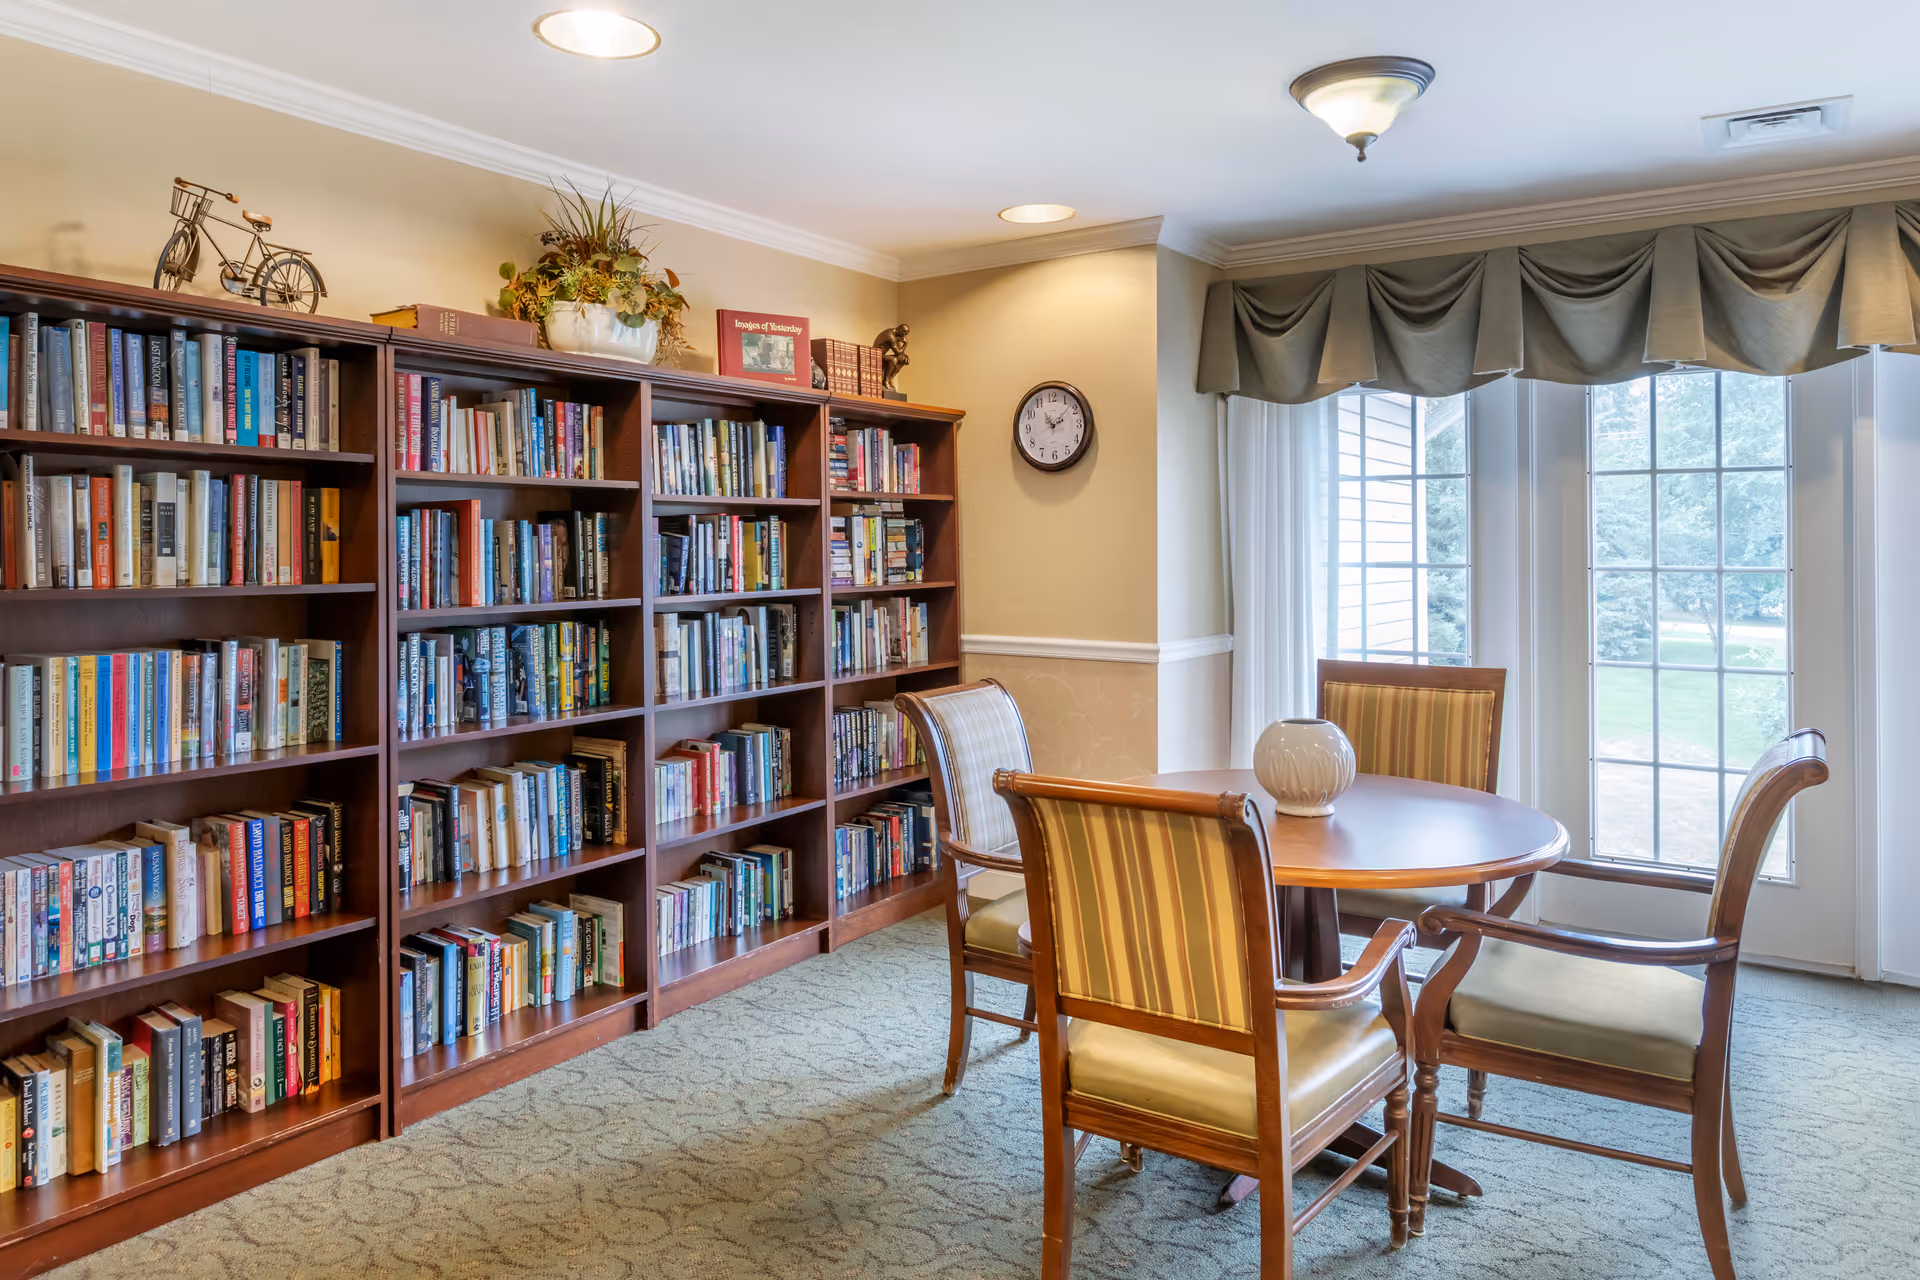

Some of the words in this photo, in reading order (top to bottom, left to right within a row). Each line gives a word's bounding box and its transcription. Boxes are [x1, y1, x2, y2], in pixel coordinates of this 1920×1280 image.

[735, 319, 761, 330] Images
[762, 322, 769, 332] of
[769, 323, 803, 335] Yesterday
[152, 341, 160, 356] LAST
[27, 353, 35, 372] Multiple
[152, 356, 161, 386] KINGDOM
[228, 357, 236, 384] LIFETIME
[228, 392, 236, 404] NOT
[431, 381, 439, 401] SANDRA
[1047, 392, 1057, 403] 12
[1063, 395, 1067, 405] 1
[411, 402, 420, 414] THE
[431, 402, 439, 423] BROWN
[1036, 398, 1043, 408] 11
[1072, 404, 1078, 415] 2
[228, 404, 236, 428] ENOUGH
[411, 416, 421, 432] LATE
[1027, 409, 1036, 420] 10
[1076, 418, 1082, 429] 3
[1026, 424, 1032, 434] 9
[1073, 434, 1079, 444] 4
[411, 435, 420, 455] SHOW
[431, 427, 439, 459] UNSPEAKABLE
[1029, 438, 1036, 448] 8
[1039, 447, 1045, 457] 7
[1065, 445, 1070, 456] 5
[1052, 450, 1058, 461] 6
[401, 554, 409, 582] DEAVER
[224, 704, 235, 738] ricochet
[234, 825, 243, 848] DAVID
[252, 823, 262, 847] DAVID
[298, 831, 306, 851] DAVID
[152, 852, 160, 875] SUSAN
[178, 840, 188, 871] EMPIRES
[235, 850, 244, 886] BALDACCI
[253, 849, 263, 888] BALDACCI
[284, 854, 292, 884] BALDACCI
[298, 854, 306, 885] BALDACCI
[105, 885, 115, 916] Christmas
[255, 890, 263, 902] END
[237, 897, 245, 920] TARGET
[255, 902, 264, 919] GAME
[105, 917, 115, 937] Magic
[128, 914, 136, 933] Dogs
[585, 968, 592, 977] X
[309, 1004, 317, 1039] FIREKEEPER'S
[226, 1044, 234, 1065] BLACK
[307, 1040, 317, 1077] DAUGHTER
[23, 1080, 32, 1098] David
[23, 1099, 32, 1126] Baldacci
